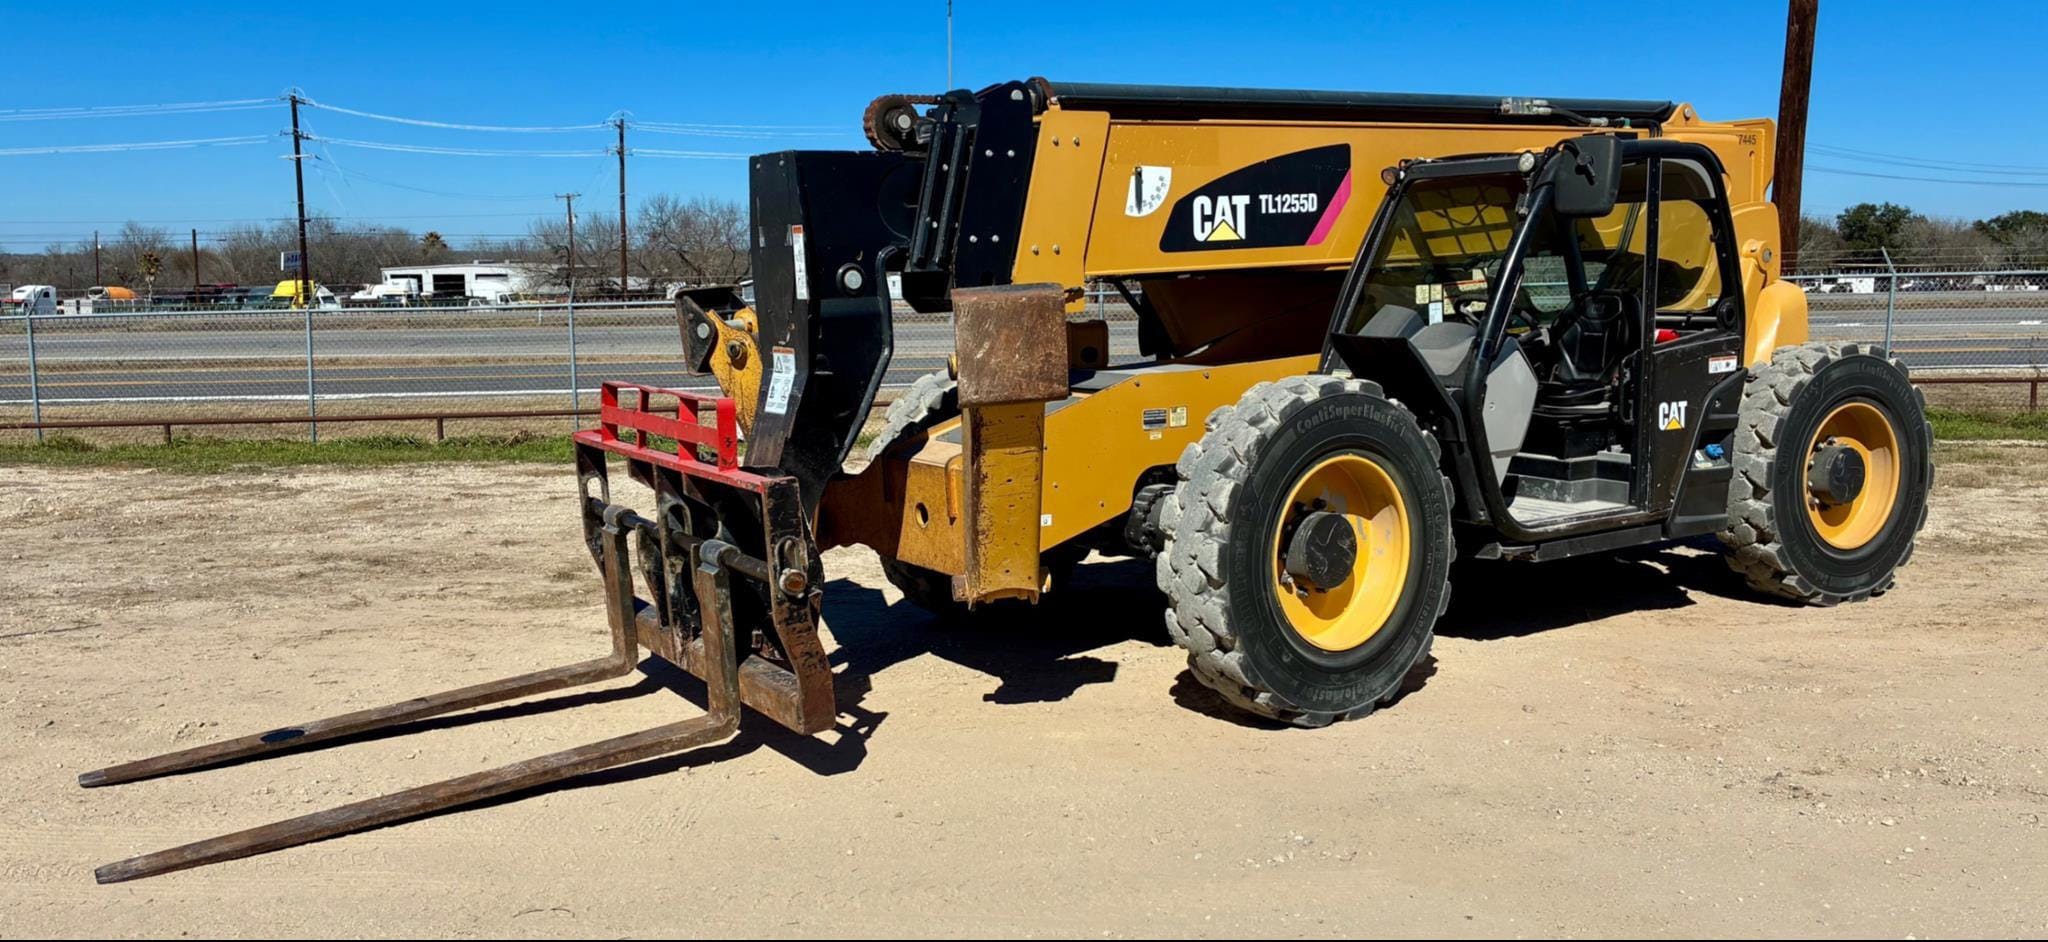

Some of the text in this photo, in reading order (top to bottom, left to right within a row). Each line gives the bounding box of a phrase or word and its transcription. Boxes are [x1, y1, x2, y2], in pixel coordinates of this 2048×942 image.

[1738, 134, 1757, 145] 7445
[1193, 194, 1251, 242] CAT
[1259, 193, 1318, 214] TL1255D
[1658, 400, 1688, 431] CAT
